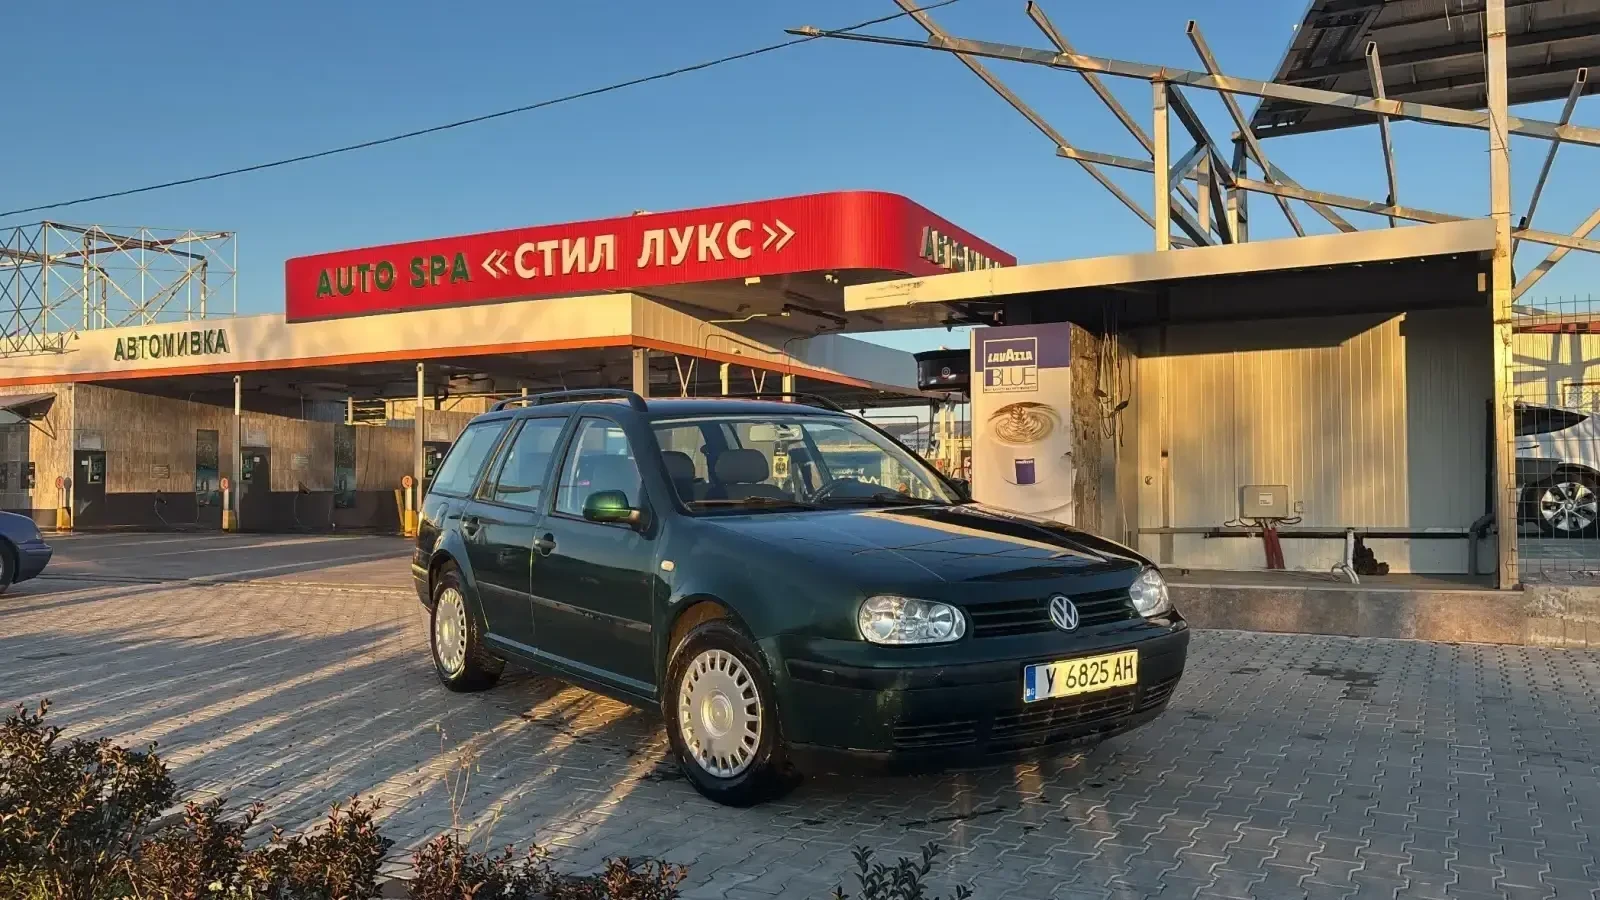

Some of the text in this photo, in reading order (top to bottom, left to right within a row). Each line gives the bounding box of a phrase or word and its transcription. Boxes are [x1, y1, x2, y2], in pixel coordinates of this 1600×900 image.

[316, 251, 474, 298] AUTO SPA
[114, 328, 231, 361] АВТОМИВКА
[985, 367, 1037, 387] BLUE
[1065, 659, 1109, 689] 6825
[1113, 655, 1134, 682] AH
